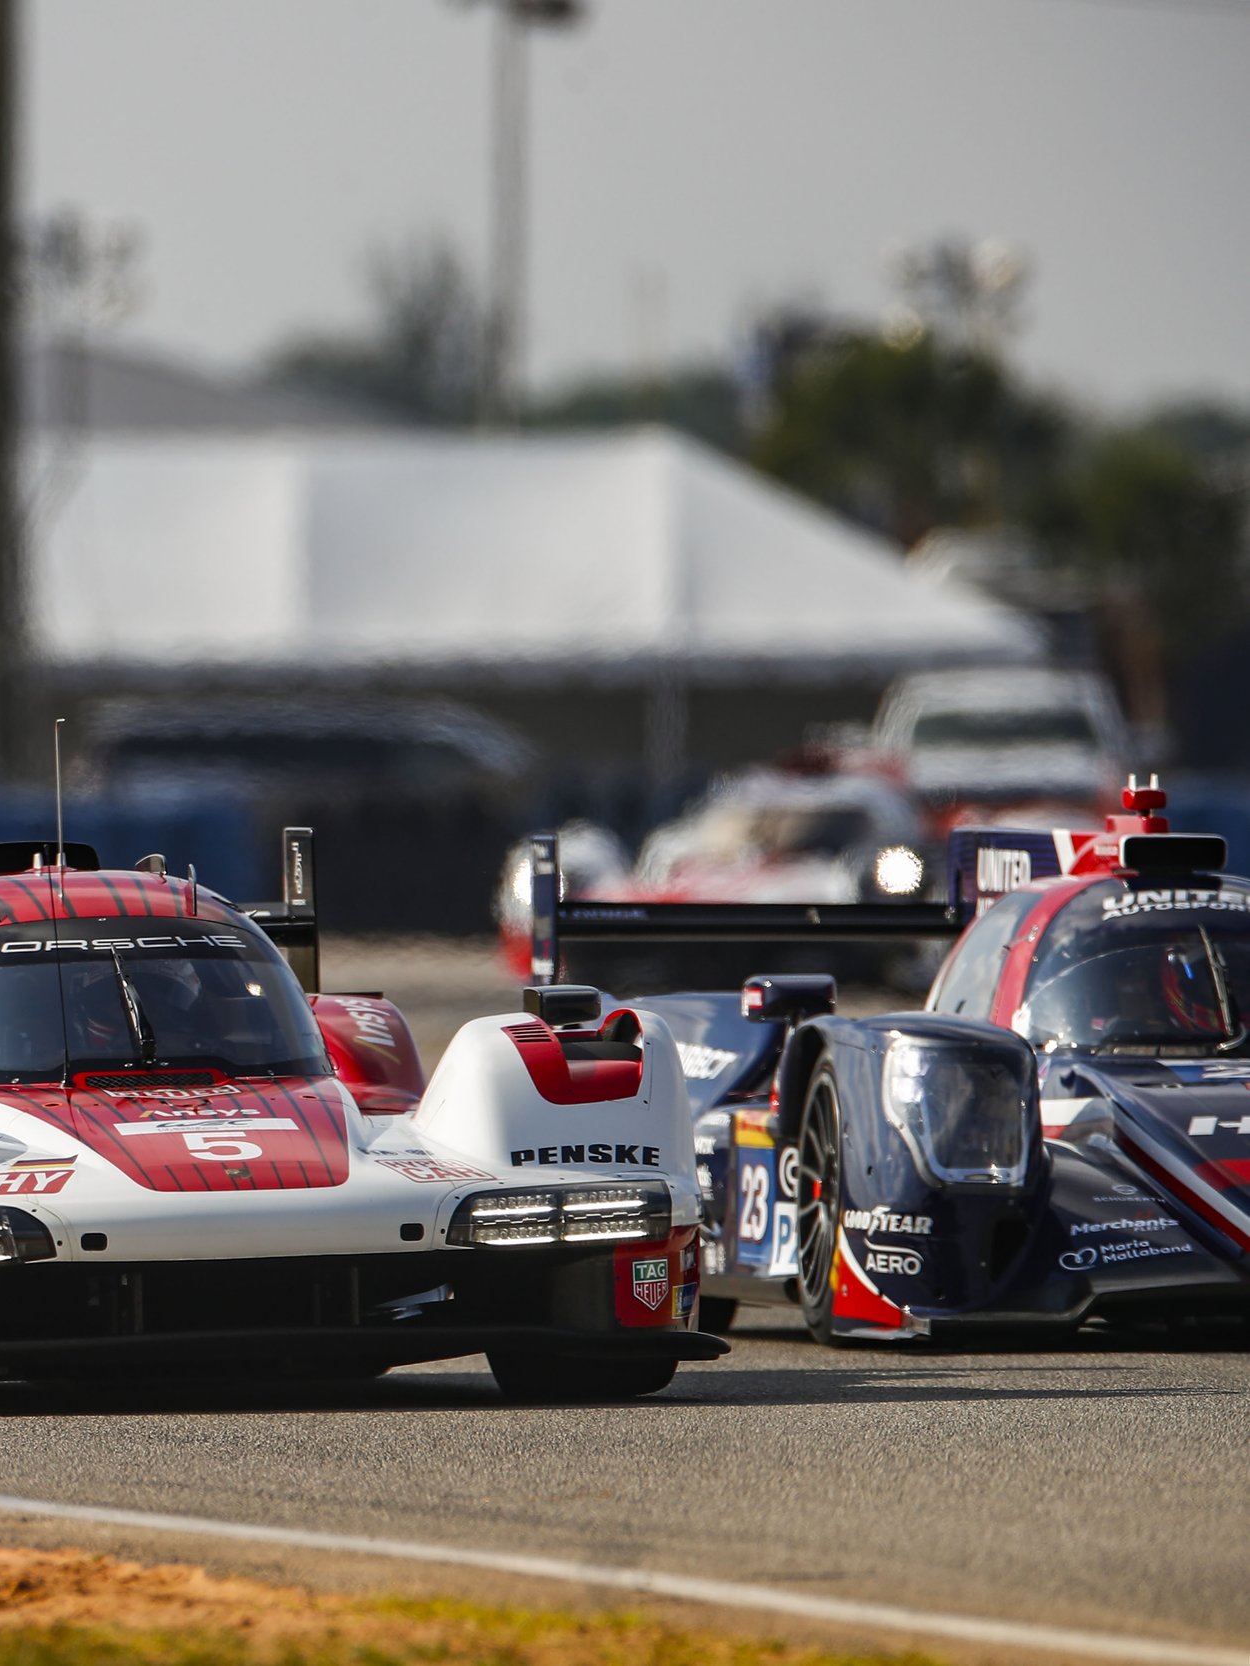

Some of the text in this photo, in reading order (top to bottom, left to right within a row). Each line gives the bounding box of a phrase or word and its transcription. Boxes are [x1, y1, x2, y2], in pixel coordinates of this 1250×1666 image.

[977, 848, 1031, 892] UNITED
[1102, 889, 1250, 911] UNITE
[1102, 902, 1250, 921] AUTOSPOR
[139, 1108, 260, 1117] Ansys
[182, 1131, 263, 1161] 5
[511, 1144, 660, 1167] PENSKE
[402, 1167, 486, 1180] CAR
[739, 1164, 769, 1241] 23
[1070, 1217, 1179, 1236] Merchants
[1100, 1240, 1149, 1254] Maria
[1103, 1244, 1193, 1263] Mallaband
[636, 1263, 666, 1279] TAG
[866, 1253, 921, 1275] AERO
[636, 1282, 667, 1306] HEUER
